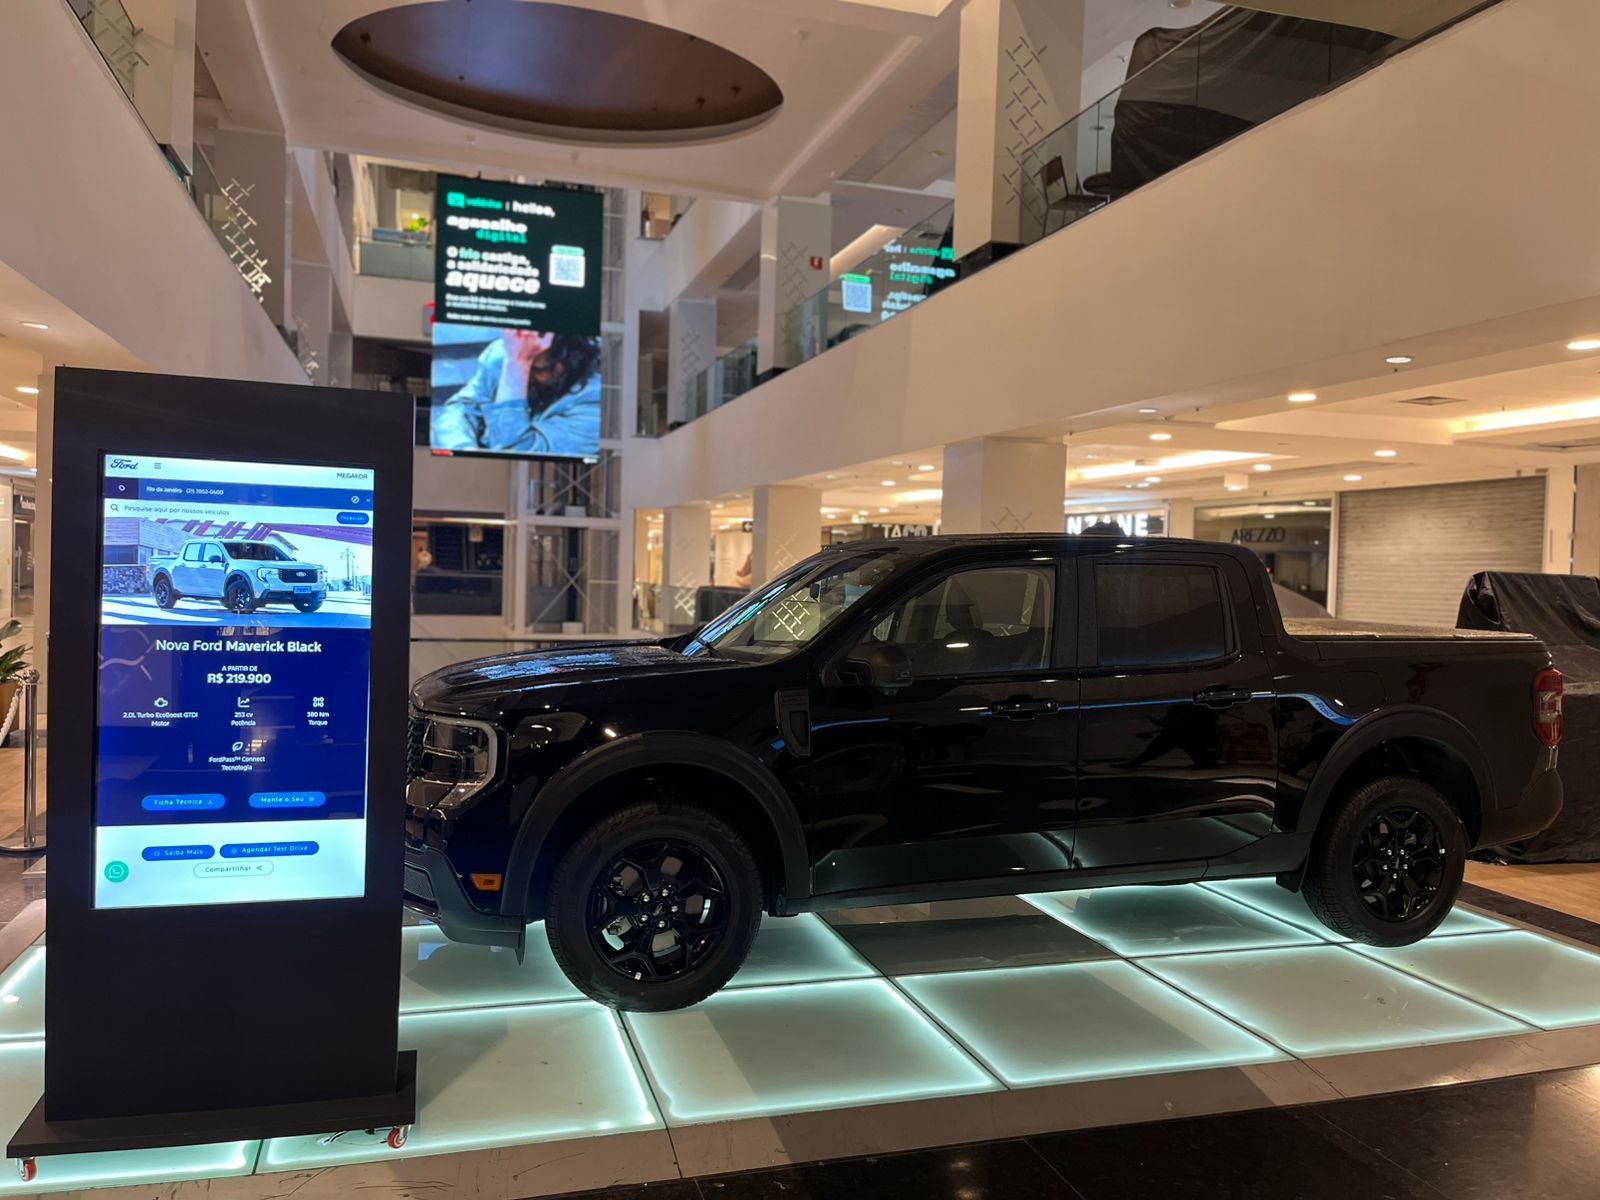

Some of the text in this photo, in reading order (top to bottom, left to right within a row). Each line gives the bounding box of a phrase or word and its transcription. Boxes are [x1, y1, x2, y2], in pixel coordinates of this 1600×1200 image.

[446, 216, 528, 233] agasalho
[476, 229, 527, 244] digital
[459, 247, 481, 261] frio
[457, 261, 540, 278] solidariedade
[445, 271, 540, 294] aquece
[110, 458, 139, 470] Ford
[1231, 526, 1286, 544] AREZZO
[156, 640, 322, 652] Nova Ford Maverick Black
[207, 673, 272, 684] R$ 219.900
[205, 865, 251, 873] Compartilhar
